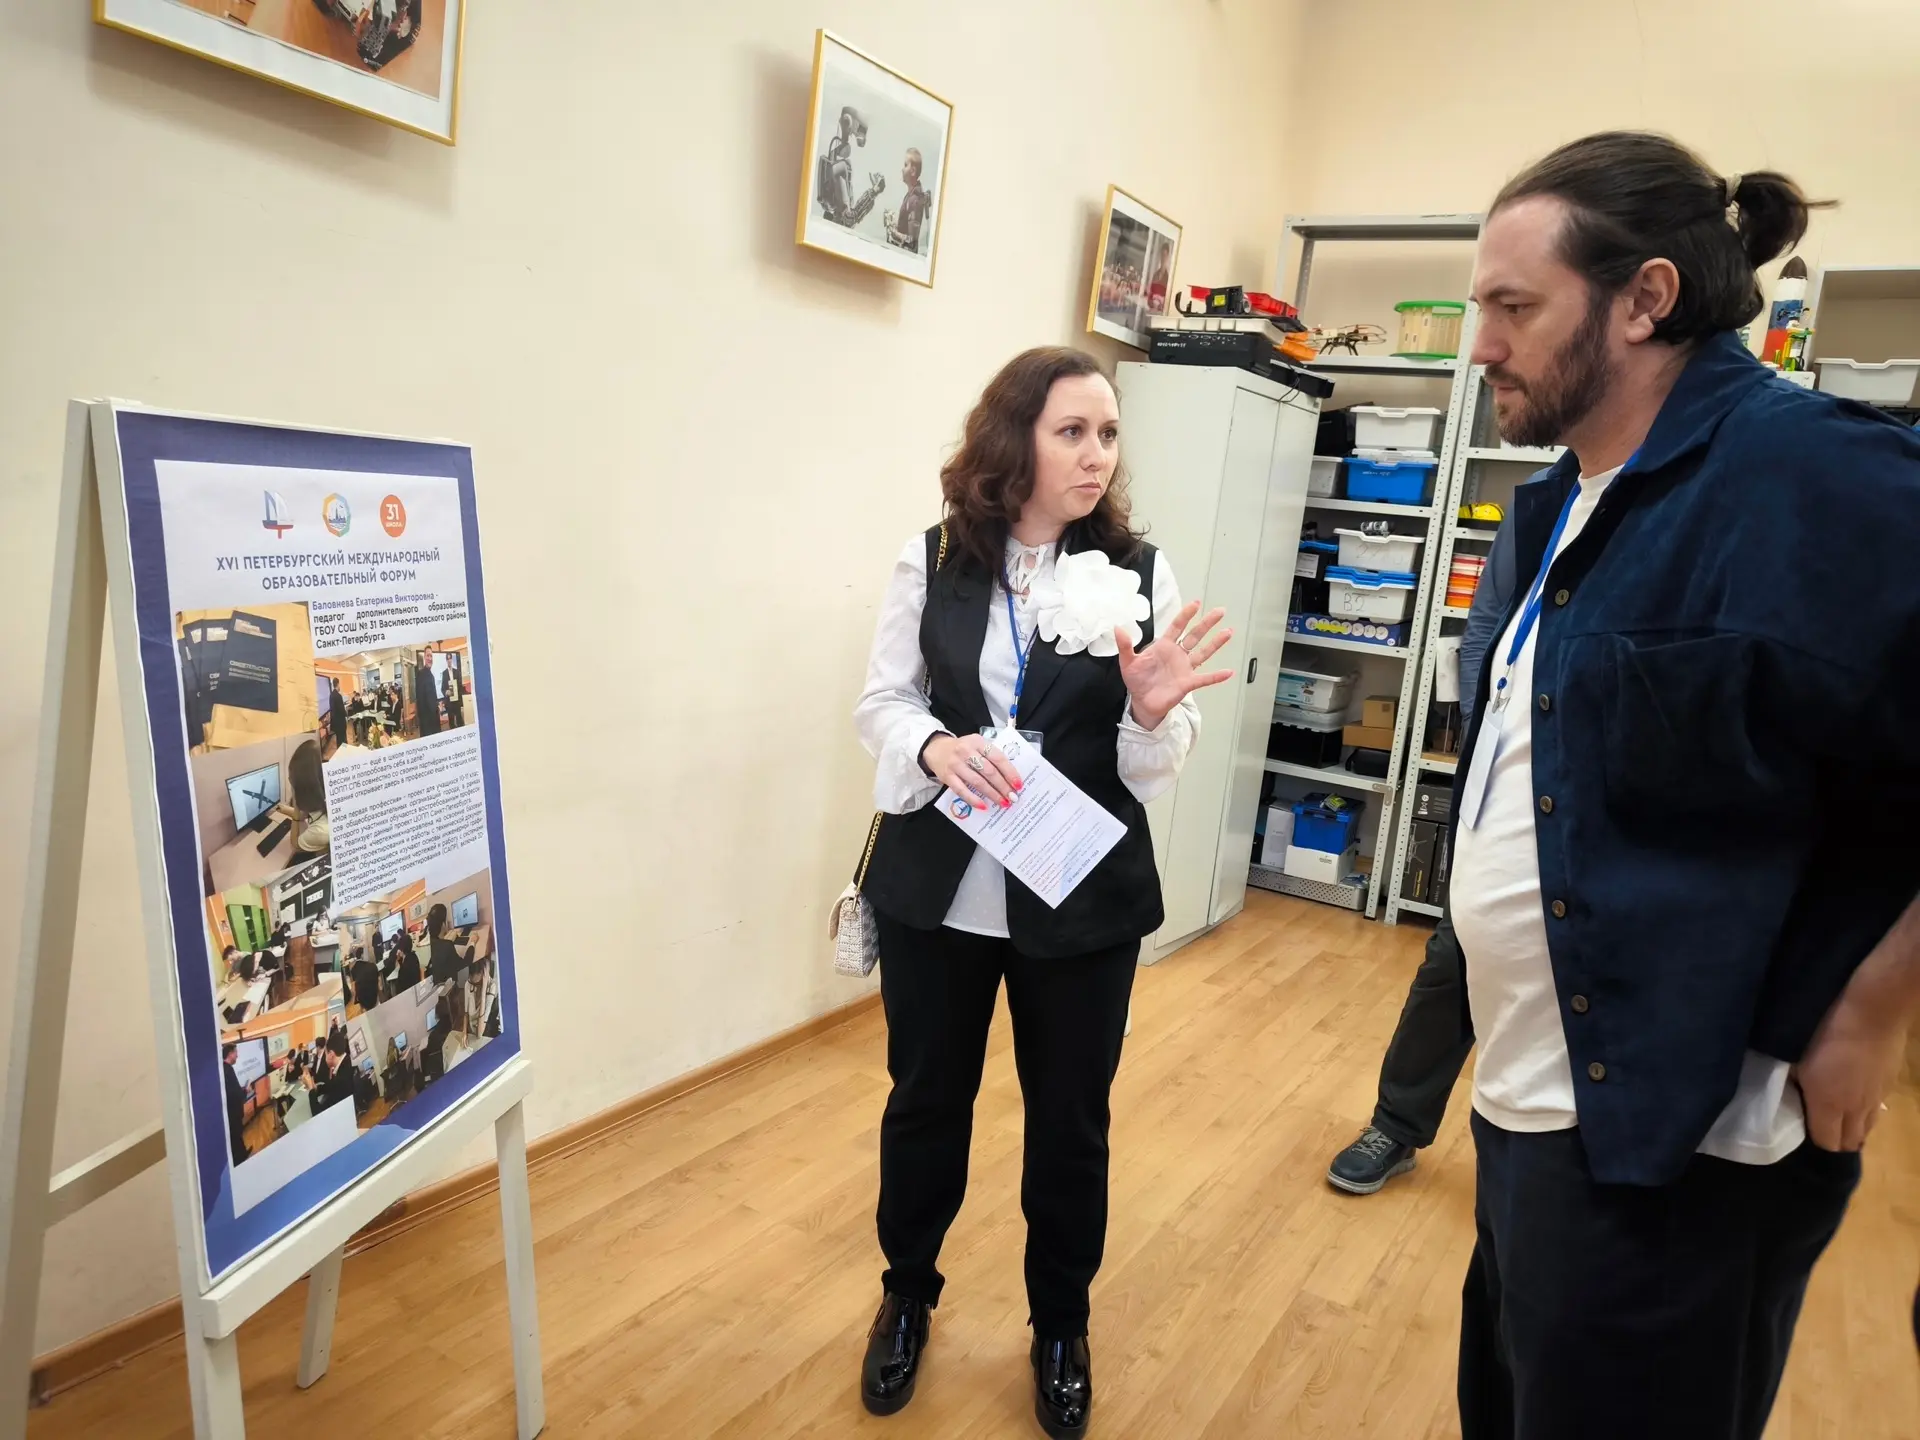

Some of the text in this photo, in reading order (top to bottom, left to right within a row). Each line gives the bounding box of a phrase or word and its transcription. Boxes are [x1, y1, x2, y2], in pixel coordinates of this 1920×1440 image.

[385, 504, 400, 520] 31
[216, 547, 441, 571] XVI ПЕТЕРБУРГСКИЙ МЕЖДУНАРОДНЫЙ
[262, 567, 417, 590] ОБРАЗОВАТЕЛЬНЫЙ ФОРУМ
[312, 598, 354, 611] Баловнева
[356, 595, 394, 608] Екатерина
[394, 592, 434, 605] Викторовна
[313, 600, 465, 624] педагог дополнительного образования
[314, 610, 467, 636] ГБОУ СОШ № 31 Василеостровского района
[316, 632, 386, 650] Санкт-Петербурга
[328, 766, 349, 778] Каково
